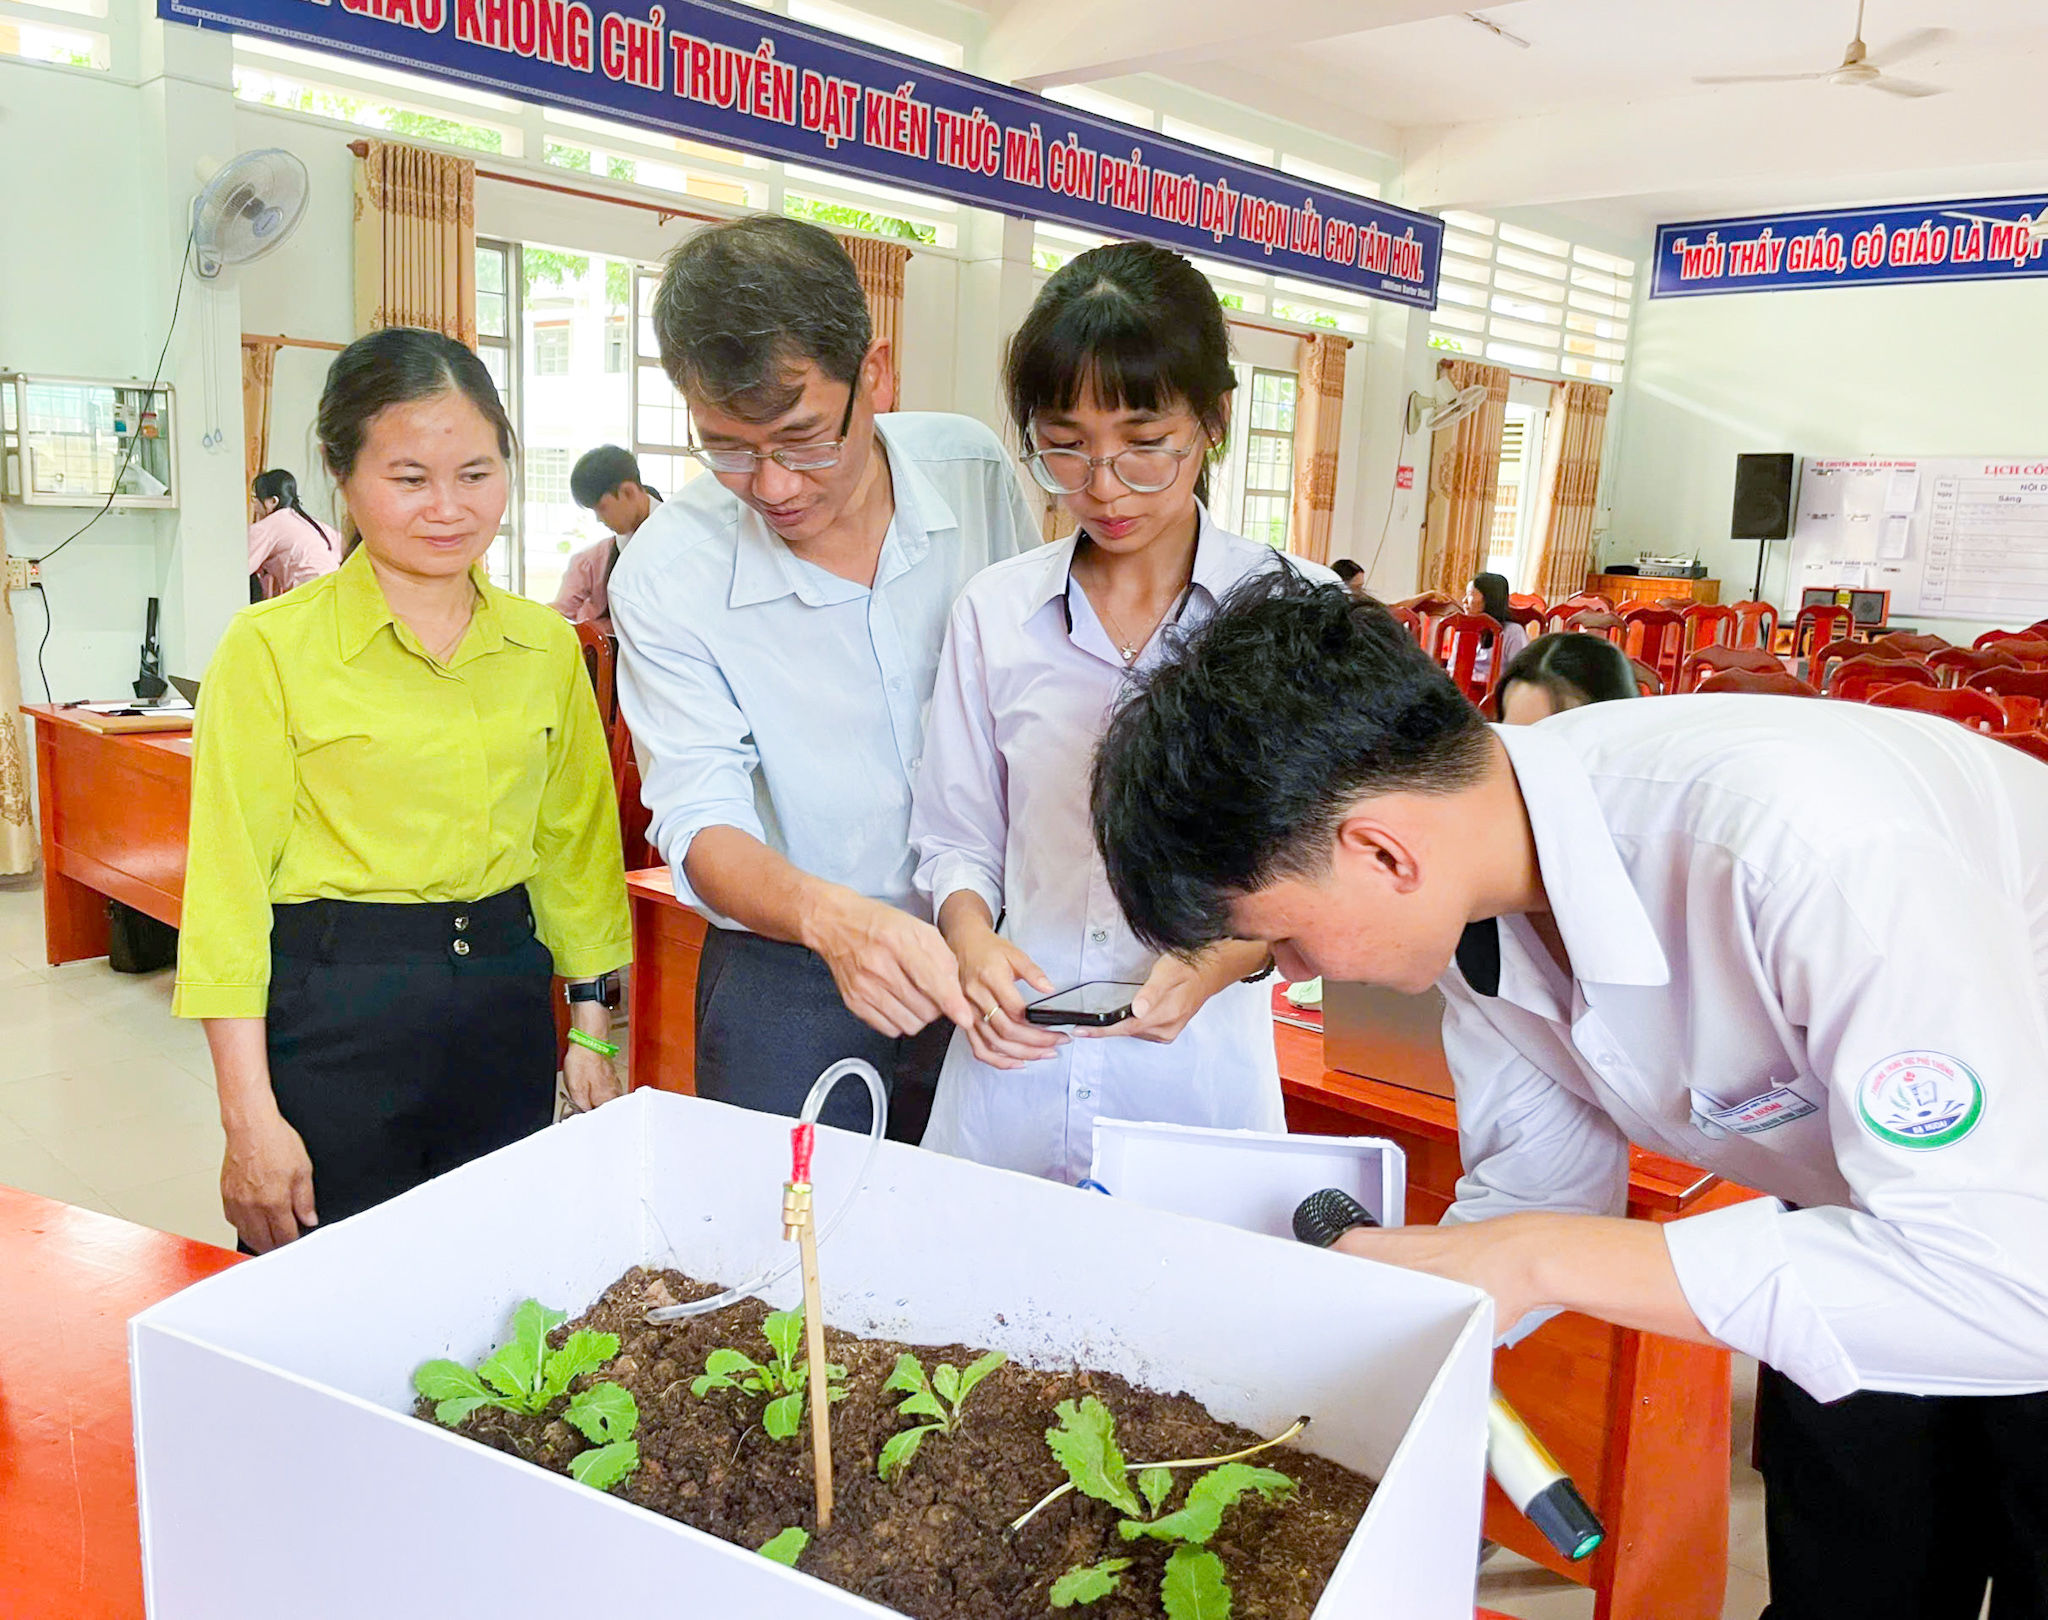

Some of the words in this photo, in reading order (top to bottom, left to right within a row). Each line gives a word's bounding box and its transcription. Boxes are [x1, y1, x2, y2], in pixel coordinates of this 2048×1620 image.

[601, 5, 665, 91] CHỈ
[670, 38, 797, 126] TRUYỀN
[802, 69, 861, 149] ĐẠT
[864, 81, 931, 160] KIẾN
[935, 106, 1000, 176] THỨC
[1003, 122, 1044, 188] MÀ
[1048, 132, 1097, 201] CÒN
[1098, 147, 1150, 215] PHẢI
[1151, 169, 1200, 227] KHƠI
[1200, 178, 1239, 243] DẬY
[1239, 194, 1290, 255] NGỌN
[1290, 197, 1322, 257] LỬA
[1324, 217, 1356, 266] CHO
[1358, 221, 1391, 275] TÂM
[1728, 227, 1786, 277] THẦY
[1787, 227, 1847, 274] GIÁO,
[1851, 223, 1886, 268] CÔ
[1889, 219, 1948, 267] GIÁO
[1951, 218, 1984, 263] LÀ
[1984, 465, 2020, 477] LỊCH
